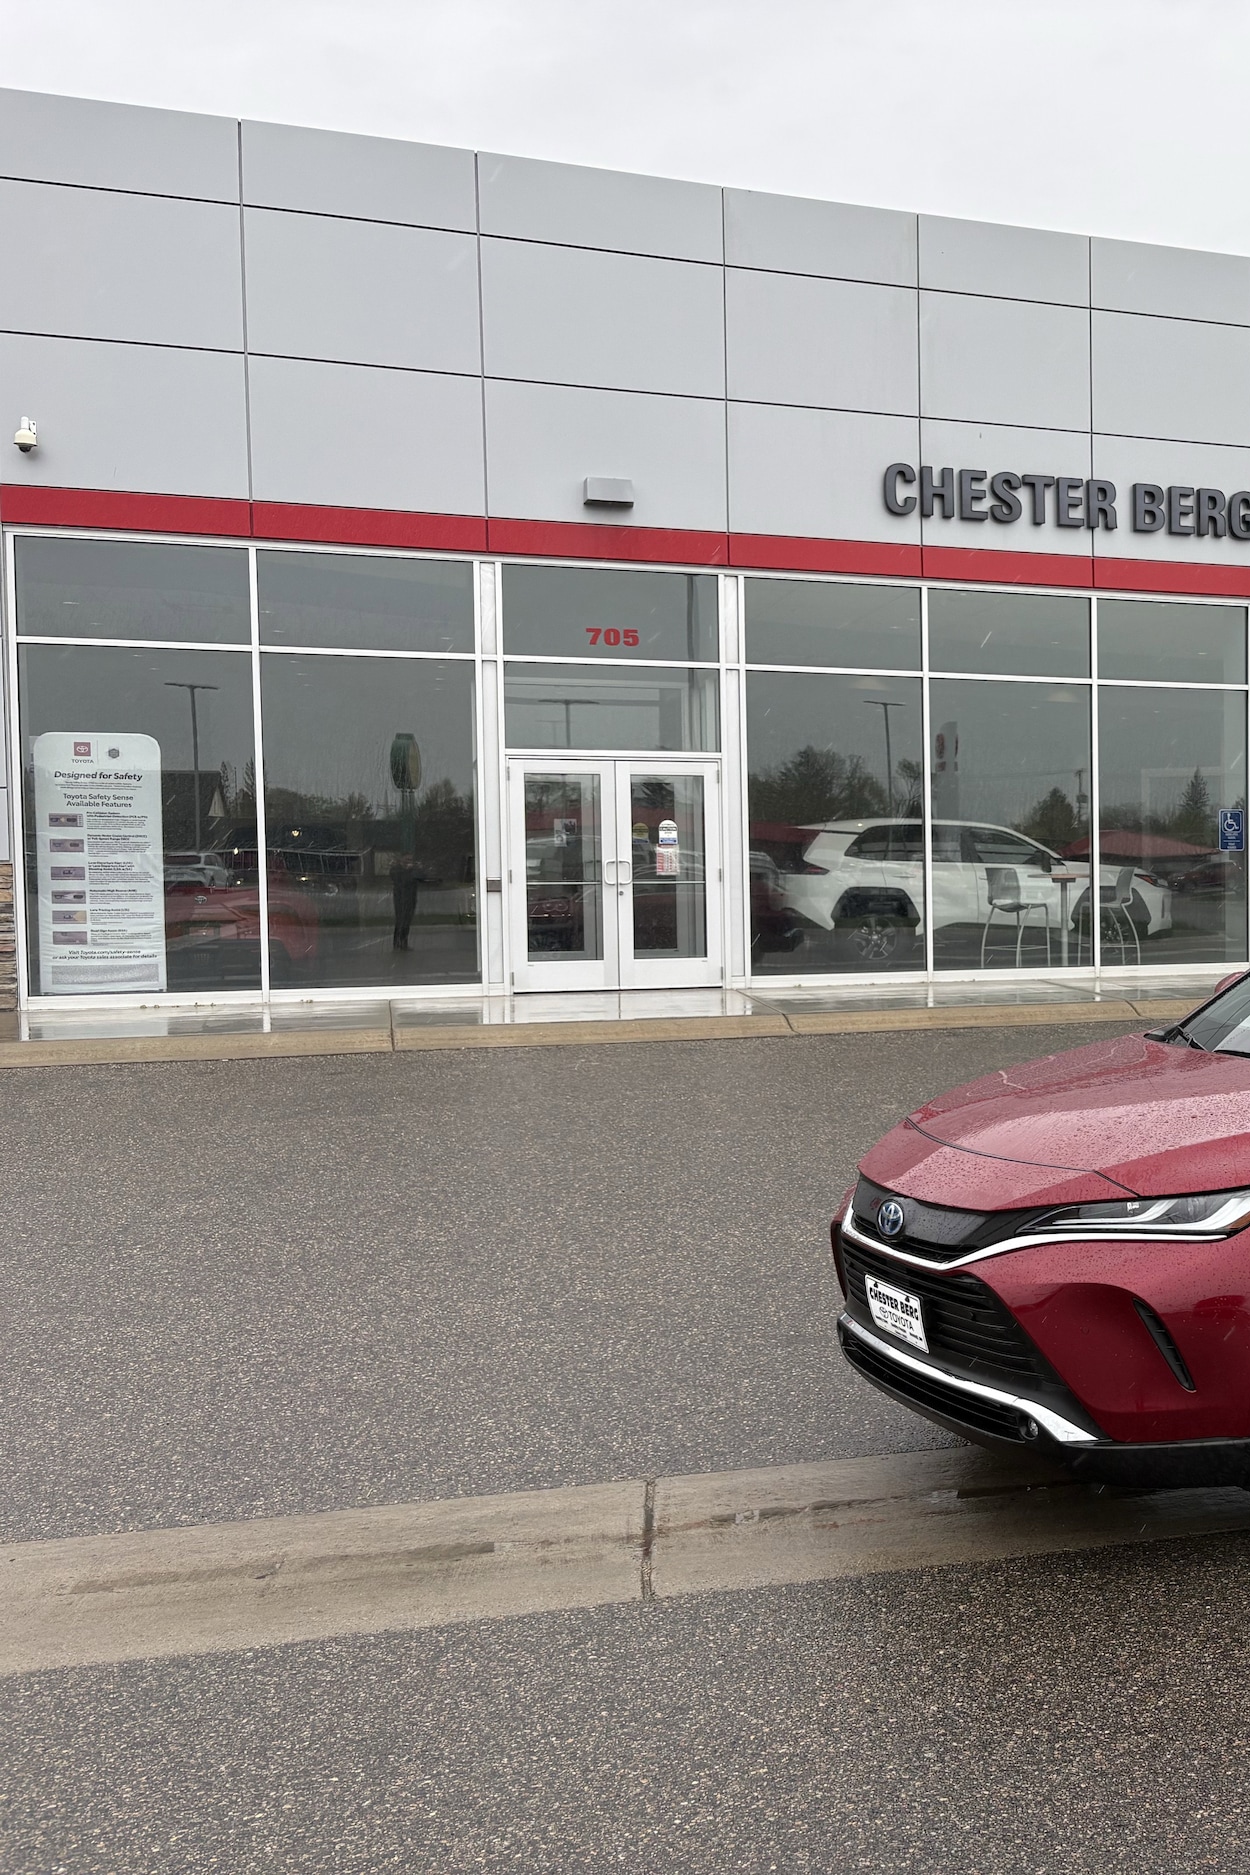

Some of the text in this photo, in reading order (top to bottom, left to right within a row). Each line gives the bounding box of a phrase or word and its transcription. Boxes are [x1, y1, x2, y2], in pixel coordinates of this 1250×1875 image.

[883, 463, 1117, 529] CHESTER
[585, 627, 640, 647] 705
[54, 770, 143, 781] Designed for Safety
[88, 793, 111, 801] Safety
[869, 1287, 899, 1312] CHESTER
[899, 1300, 919, 1321] BERG
[887, 1310, 915, 1332] TOYOTA
